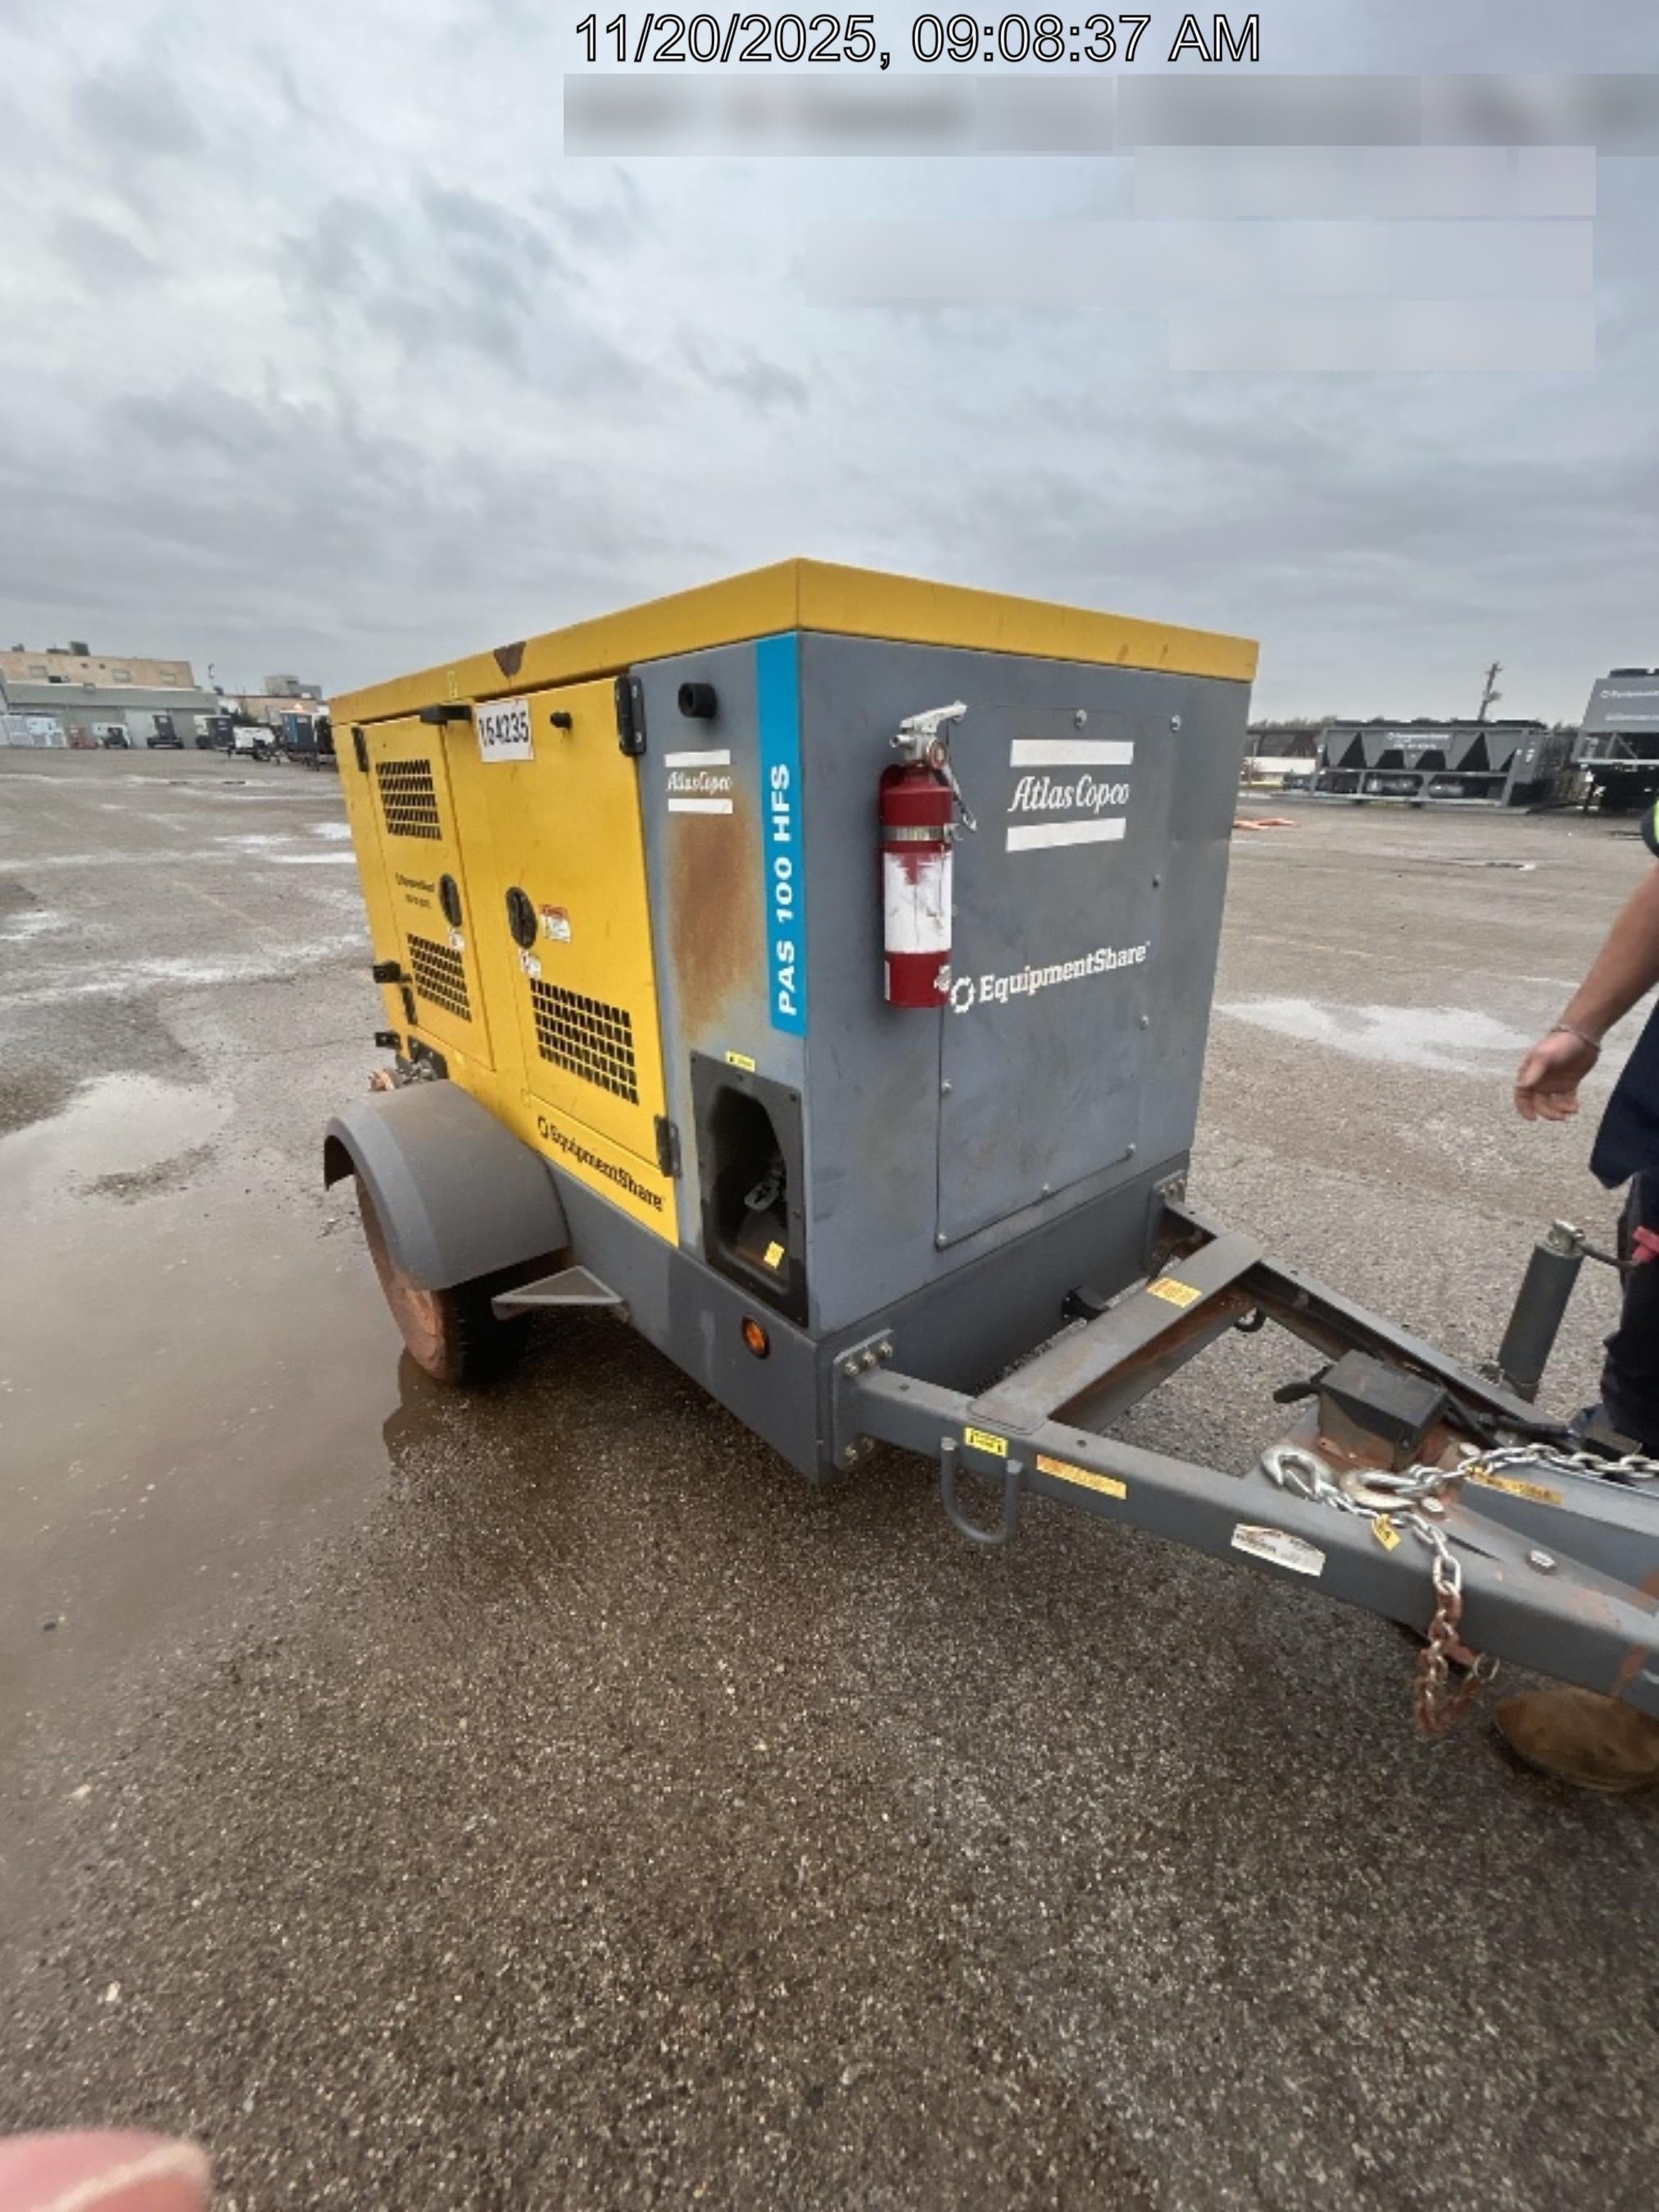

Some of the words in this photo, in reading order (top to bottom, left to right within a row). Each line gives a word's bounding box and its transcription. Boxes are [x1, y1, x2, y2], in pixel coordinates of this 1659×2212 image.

[771, 763, 791, 843] HFS
[1007, 775, 1075, 812] Atlas
[1076, 773, 1130, 814] Copco
[774, 856, 793, 923] 100
[777, 940, 797, 1016] PAS
[549, 1122, 664, 1213] EquipmentShare
